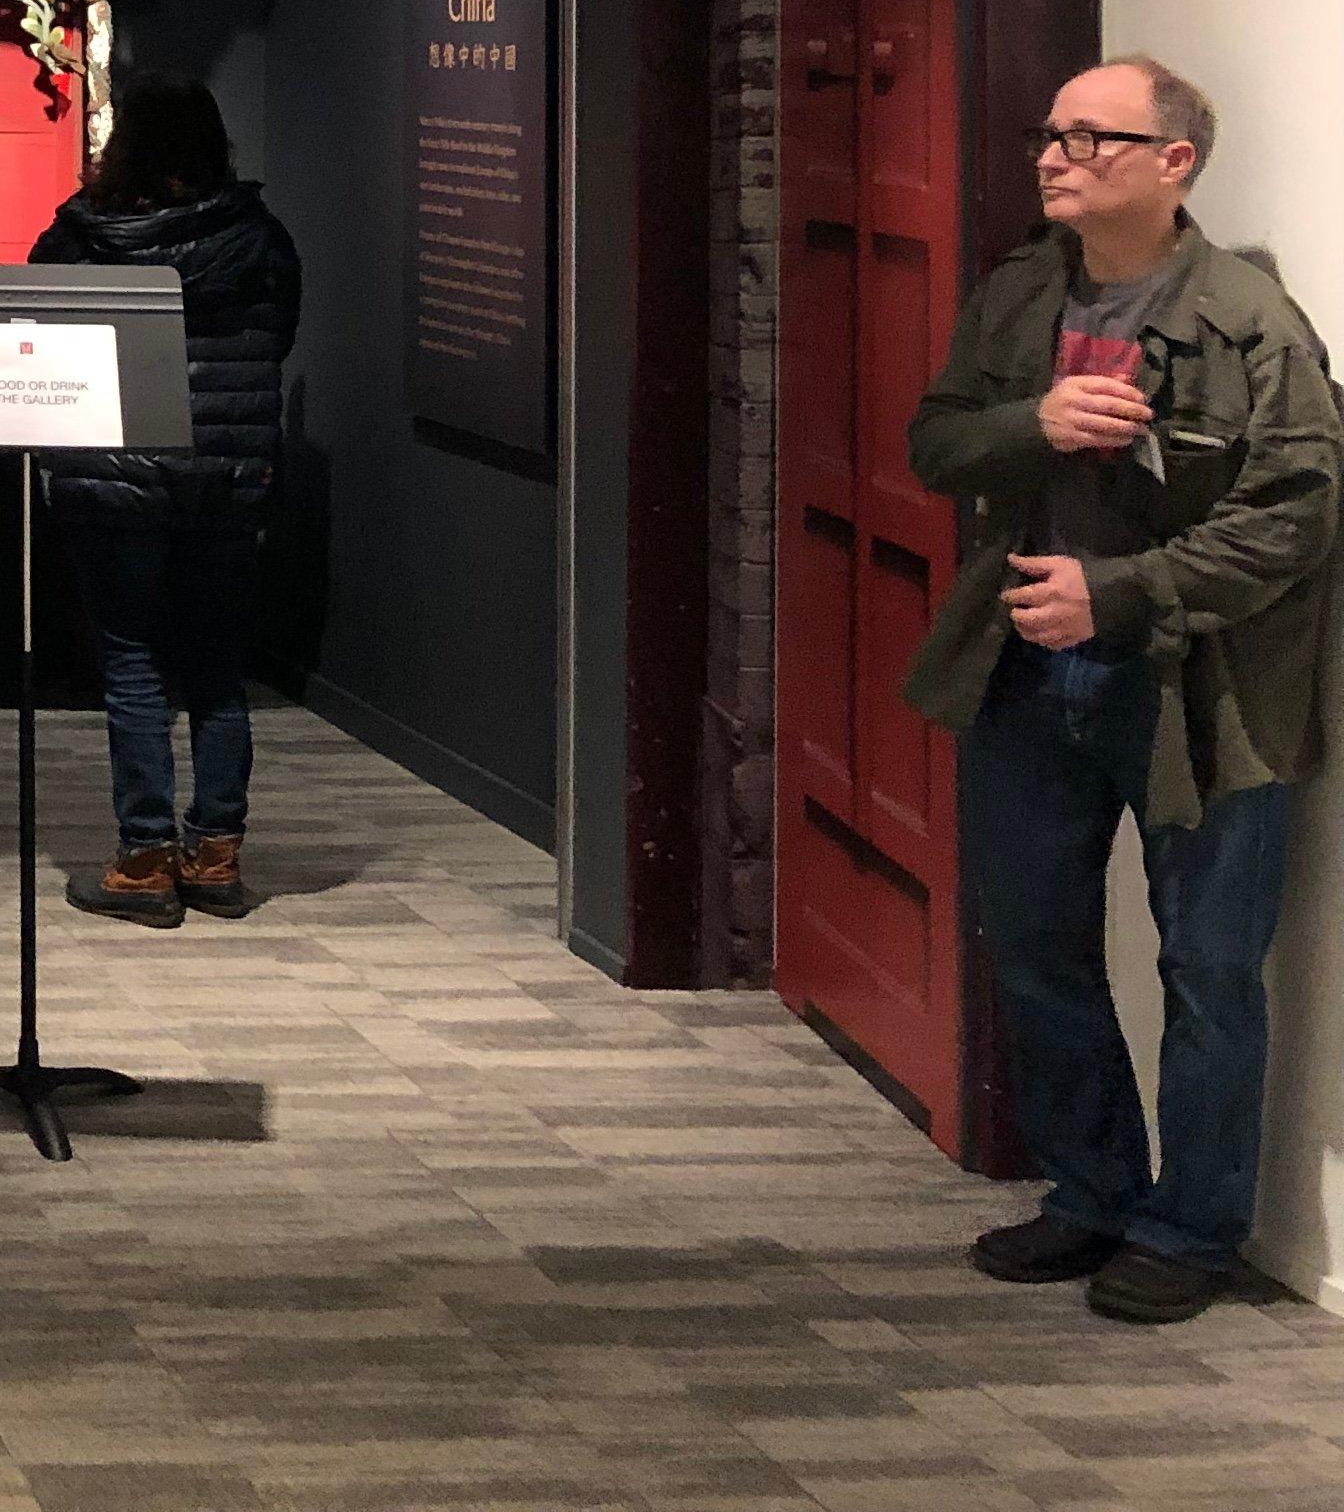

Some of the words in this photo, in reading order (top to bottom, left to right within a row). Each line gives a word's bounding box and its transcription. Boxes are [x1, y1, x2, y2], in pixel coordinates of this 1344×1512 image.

[29, 381, 47, 390] OR
[51, 382, 88, 390] DRINK
[23, 395, 77, 405] GALLERY
